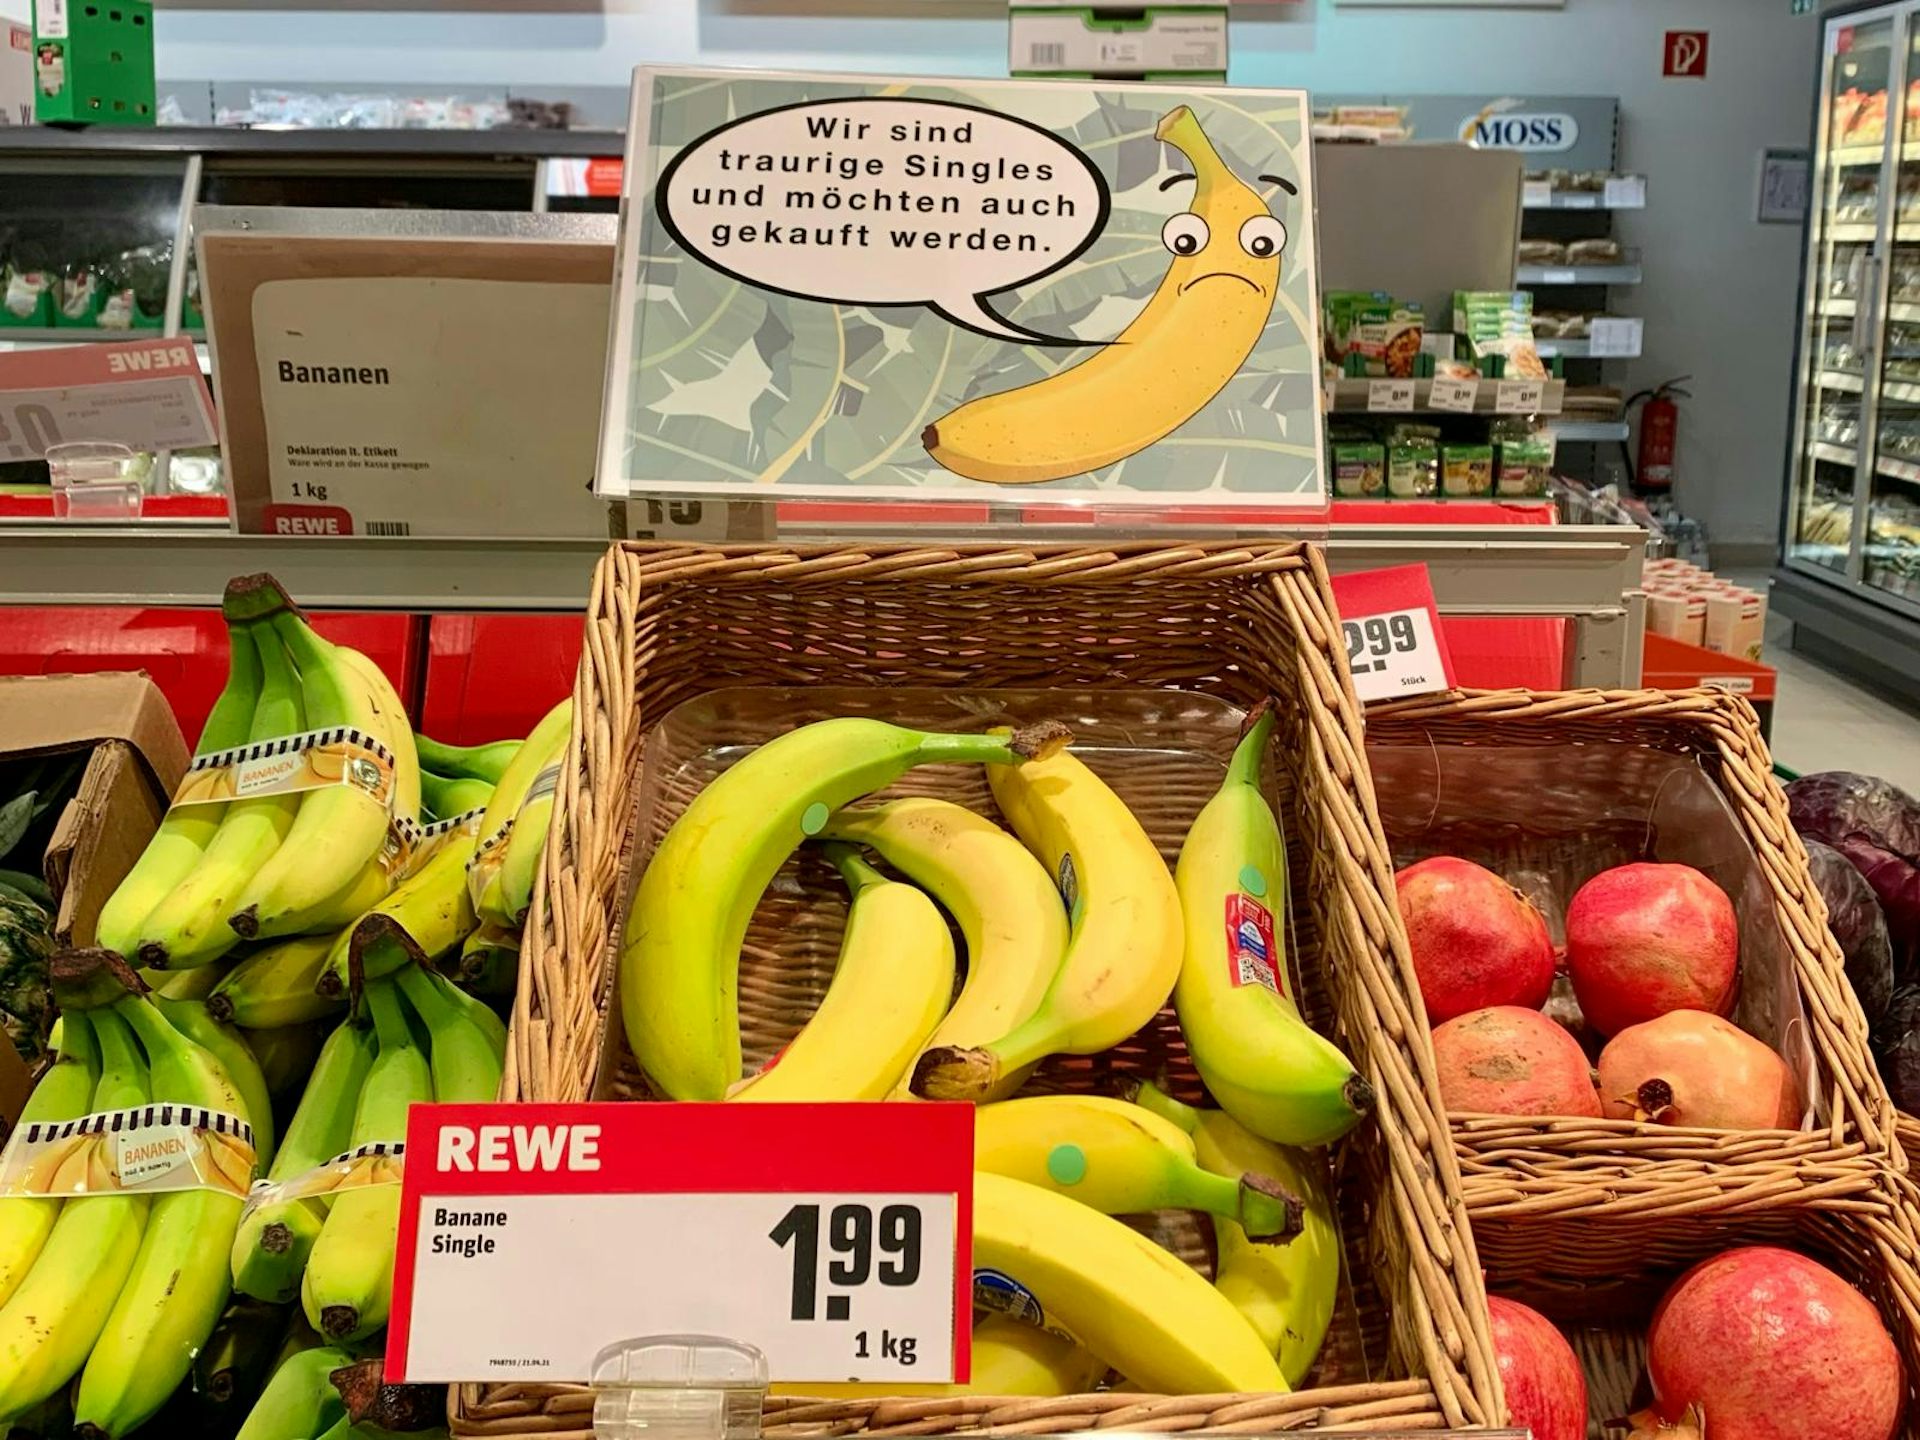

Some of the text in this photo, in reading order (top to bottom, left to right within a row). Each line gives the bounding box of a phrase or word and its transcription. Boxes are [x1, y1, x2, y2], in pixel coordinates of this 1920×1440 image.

[806, 116, 974, 144] Wir sind
[1474, 118, 1562, 146] MOSS
[719, 149, 1053, 184] traurige Singles
[692, 184, 1076, 217] und möchten auch
[711, 220, 1051, 252] gekauft werden.
[278, 360, 389, 385] Bananen
[287, 445, 347, 456] Deklaration
[363, 446, 398, 457] Etikett
[288, 458, 311, 467] Ware
[313, 458, 332, 467] wird
[347, 459, 361, 468] der
[391, 461, 430, 471] gewogen
[291, 481, 328, 500] 1 kg
[275, 516, 340, 534] REWE
[1342, 614, 1417, 674] 2.99
[1401, 676, 1427, 686] Stück
[243, 759, 294, 783] BANANEN
[124, 1136, 187, 1165] BANANEN
[437, 1125, 602, 1172] REWE
[434, 1208, 507, 1228] Banane
[431, 1234, 495, 1258] Single
[768, 1204, 921, 1321] 1.99
[855, 1329, 917, 1365] 1 kg
